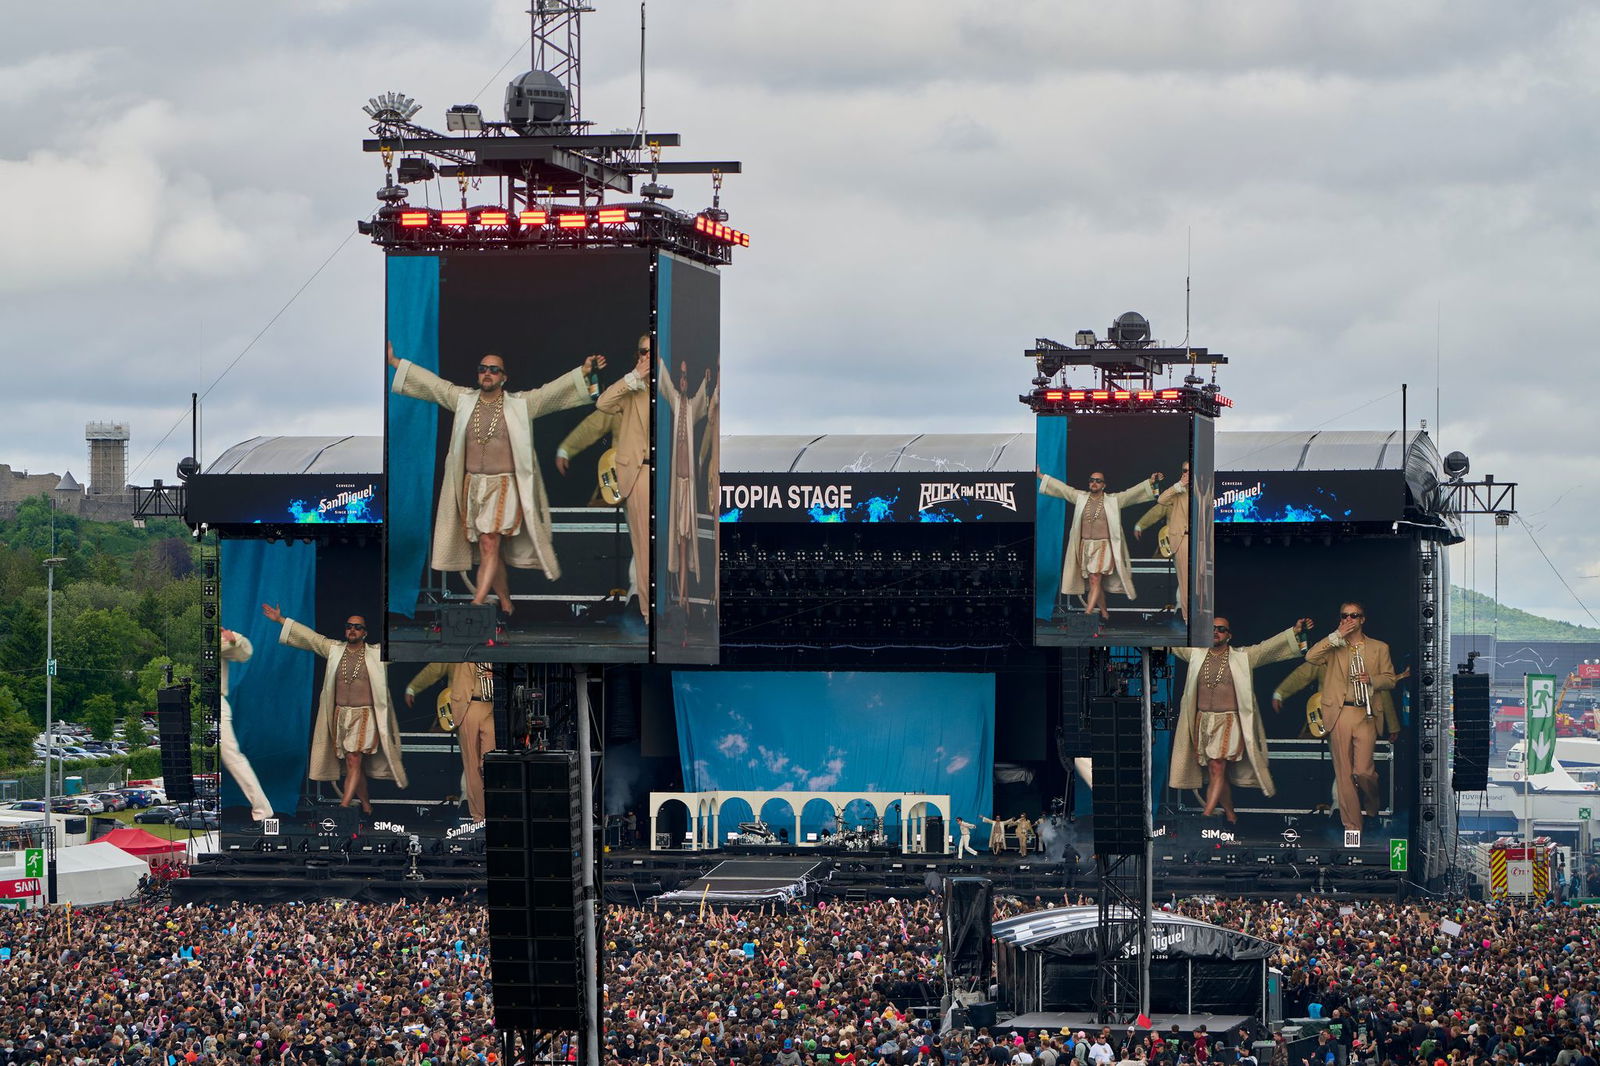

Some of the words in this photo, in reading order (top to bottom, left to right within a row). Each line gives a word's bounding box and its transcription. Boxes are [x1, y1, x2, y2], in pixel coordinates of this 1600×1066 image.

[719, 485, 783, 509] TOPIA
[788, 485, 852, 509] STAGE
[919, 483, 960, 512] ROCK
[975, 483, 1017, 512] RING
